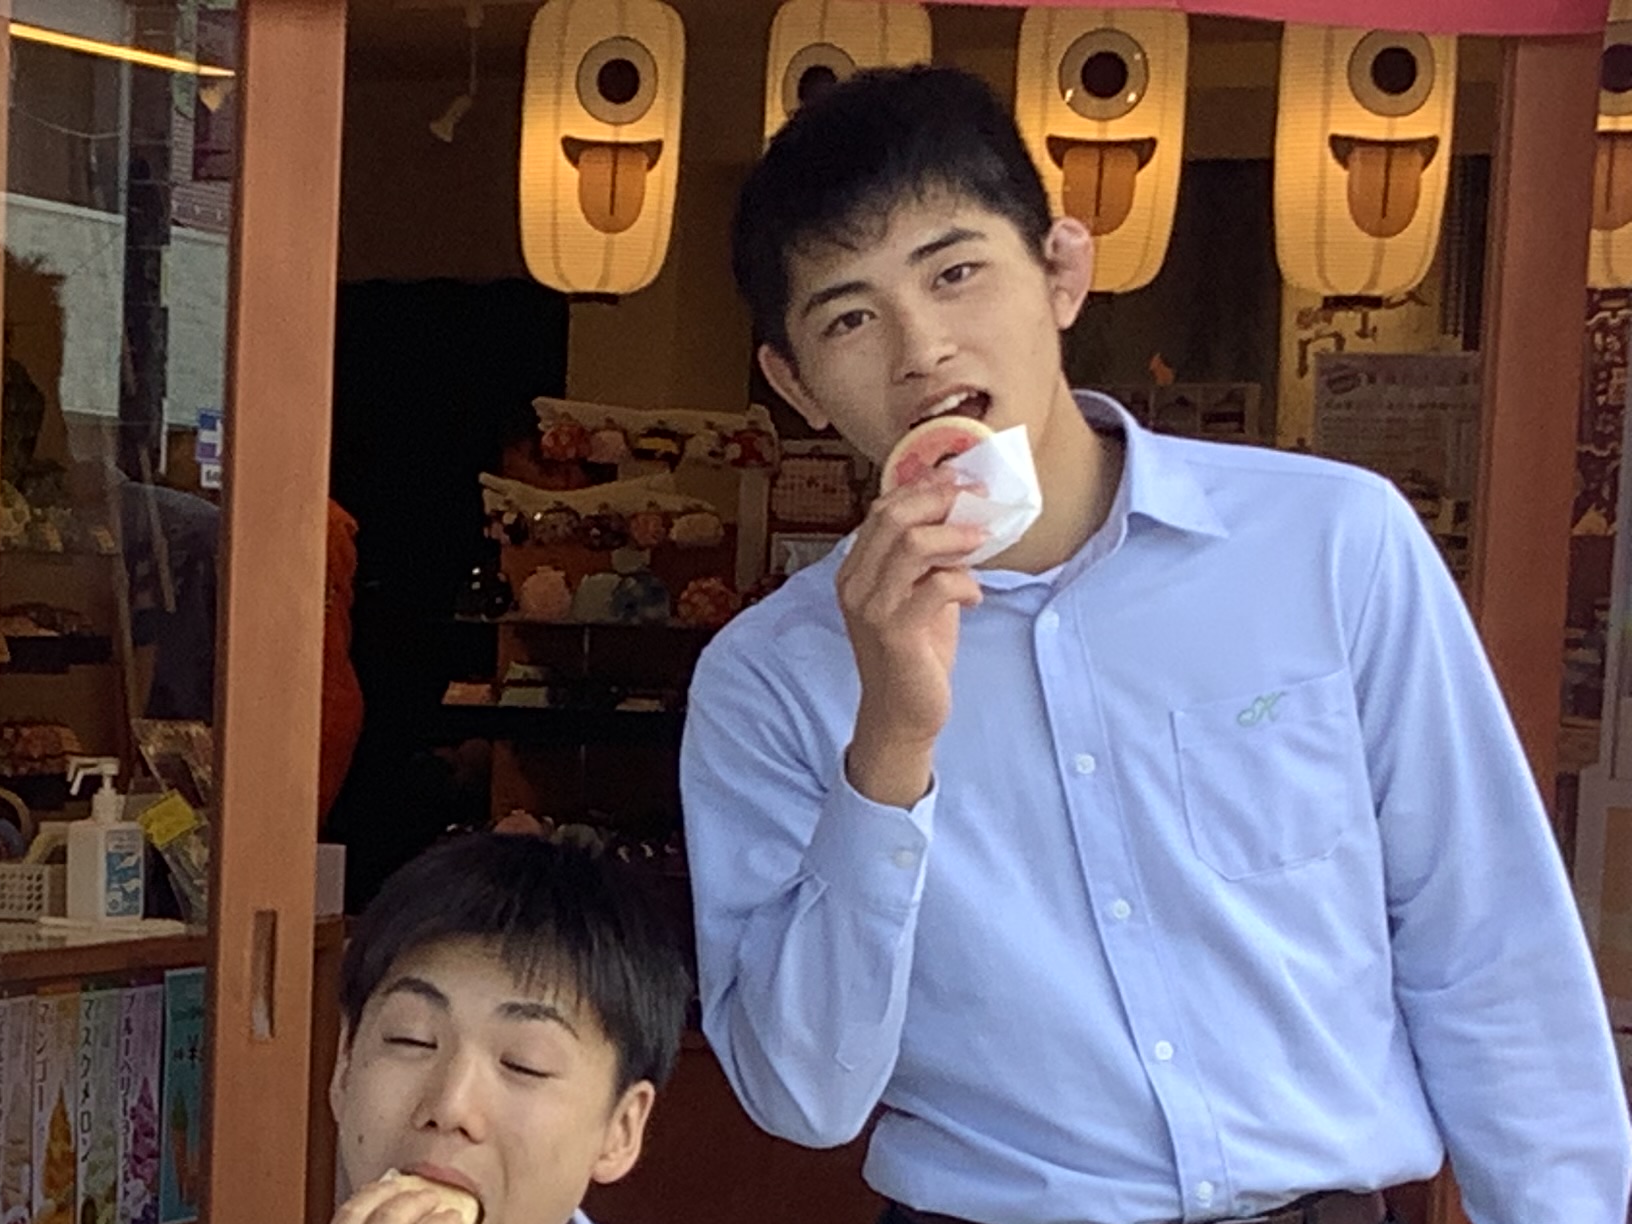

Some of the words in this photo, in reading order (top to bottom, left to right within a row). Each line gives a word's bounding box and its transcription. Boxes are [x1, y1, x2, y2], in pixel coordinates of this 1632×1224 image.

[79, 999, 93, 1164] マスクメロン
